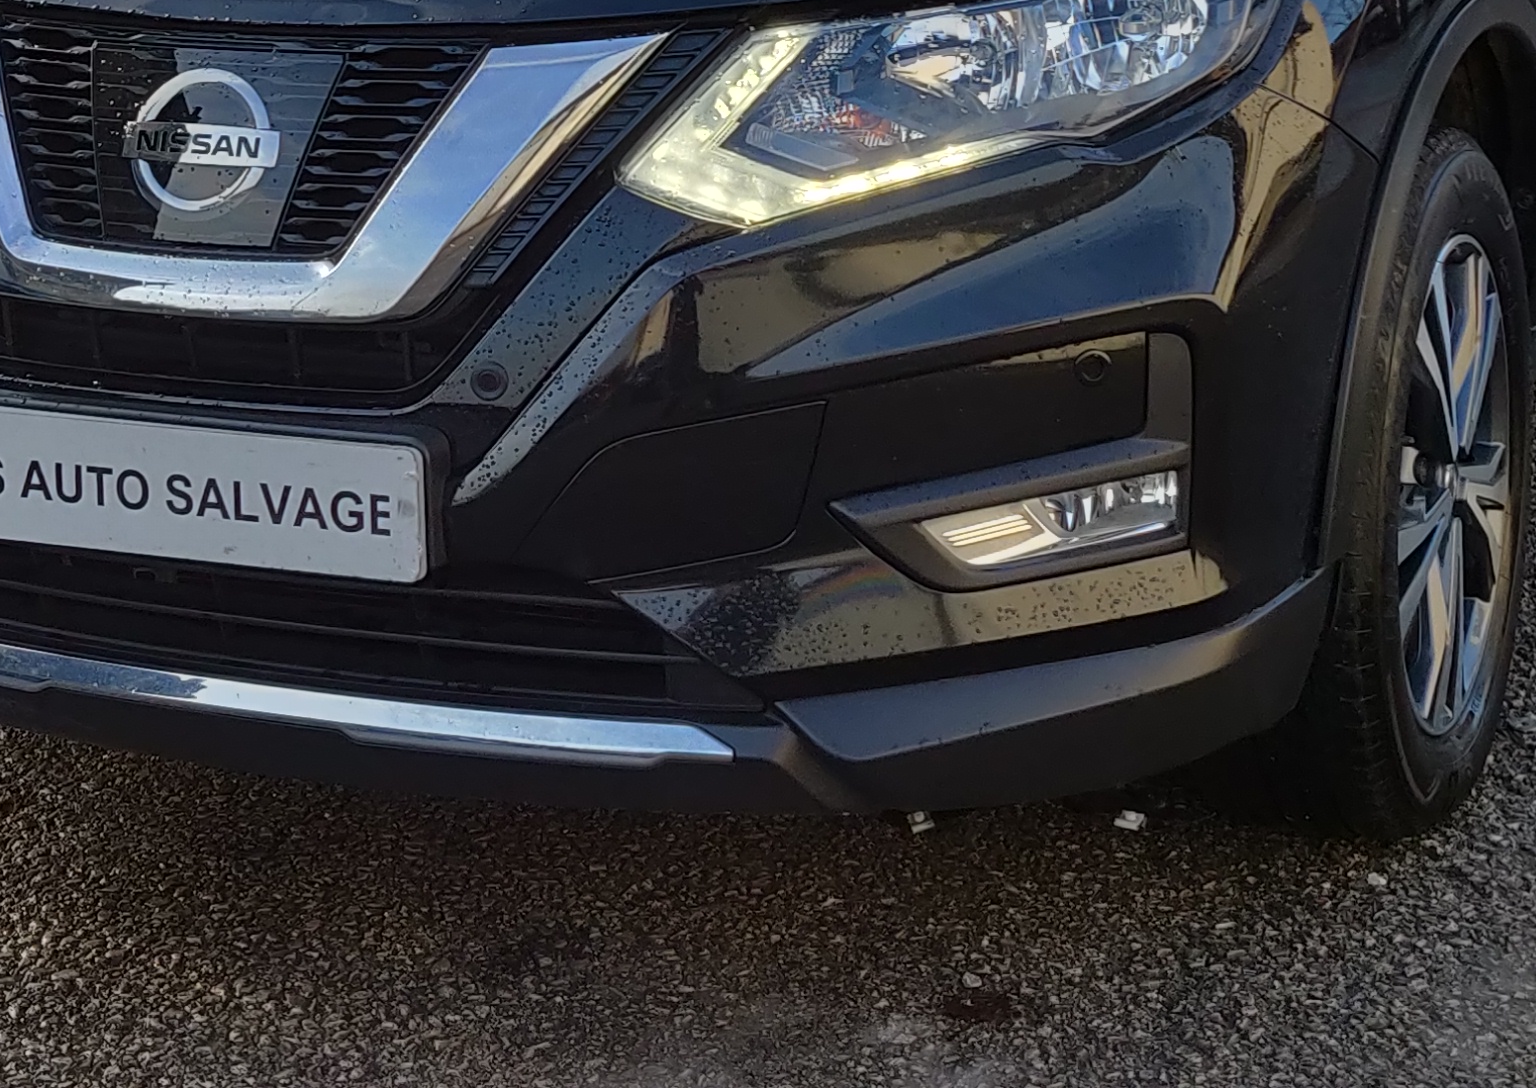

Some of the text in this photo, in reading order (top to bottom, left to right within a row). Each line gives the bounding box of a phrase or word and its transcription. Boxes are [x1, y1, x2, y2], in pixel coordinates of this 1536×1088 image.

[136, 129, 261, 159] NISSAN
[20, 459, 150, 511] AUTO
[164, 474, 392, 537] SALVAGE
